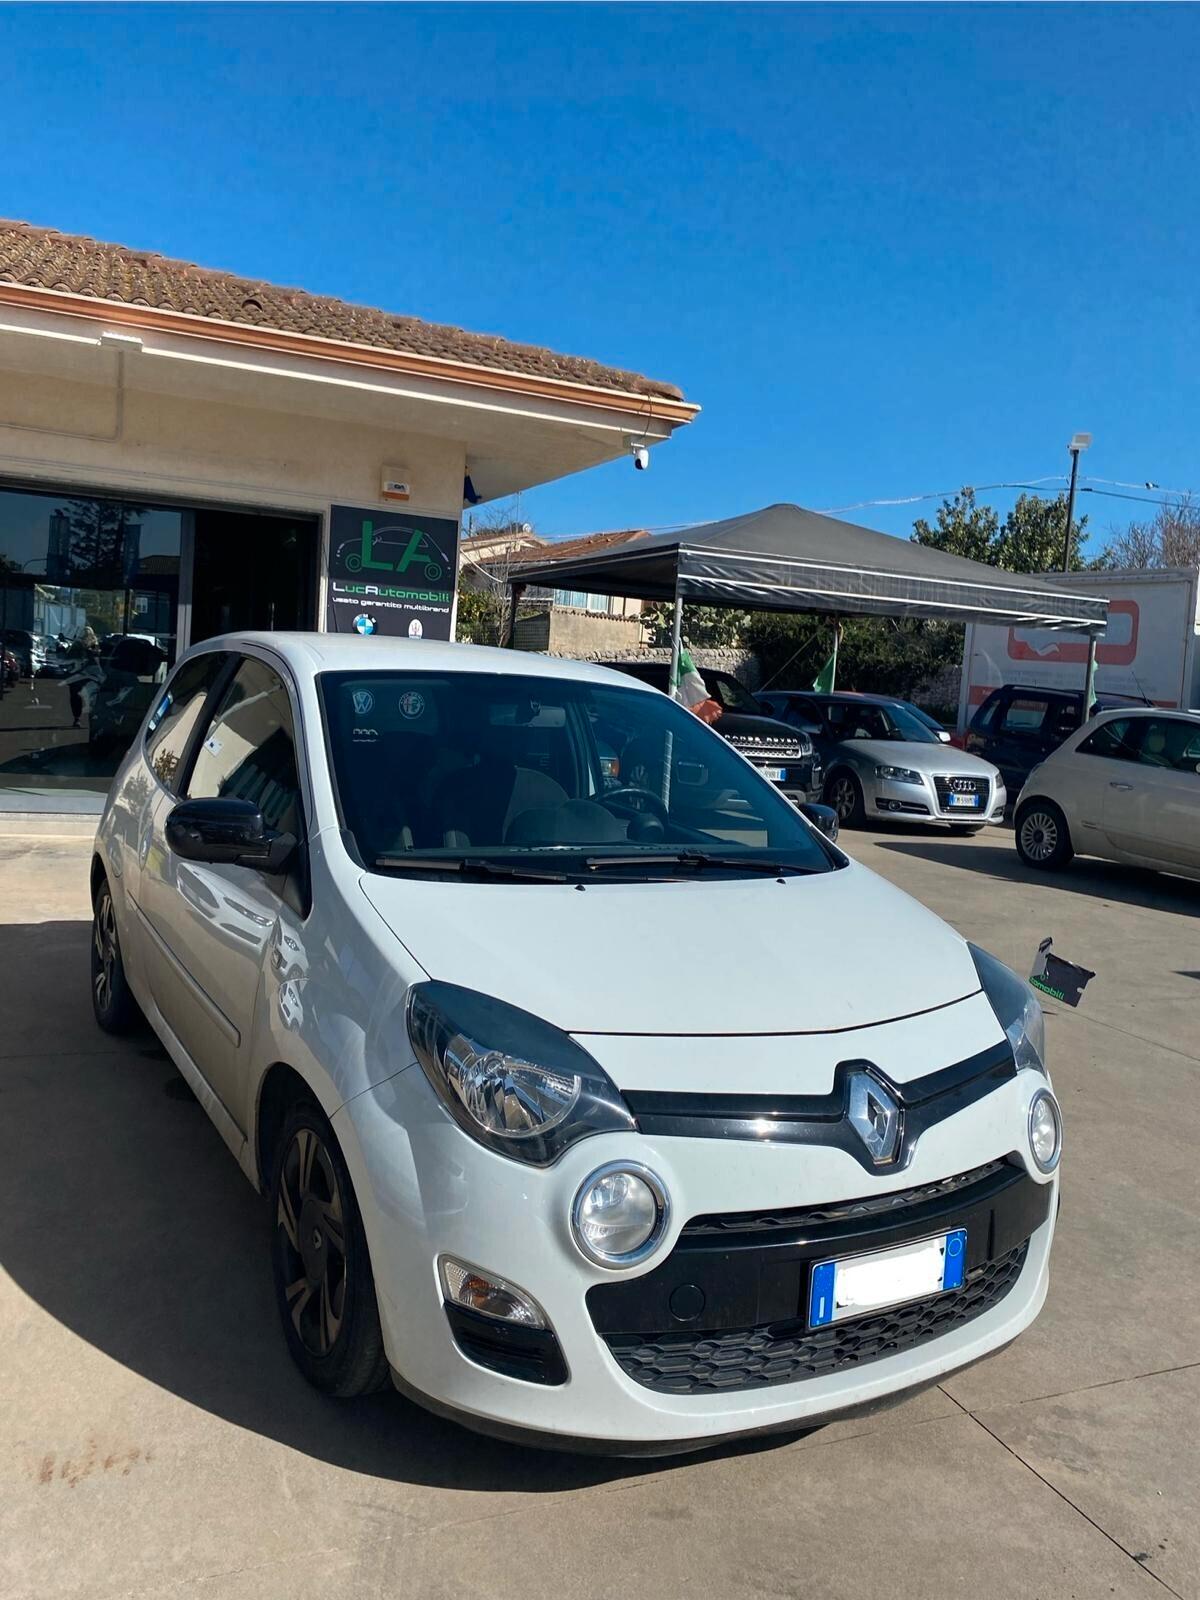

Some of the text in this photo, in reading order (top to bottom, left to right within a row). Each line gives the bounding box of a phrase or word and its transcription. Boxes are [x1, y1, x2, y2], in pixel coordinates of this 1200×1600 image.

[362, 520, 432, 572] LA
[332, 581, 450, 602] LucAutomobili
[332, 597, 450, 613] usato garantito multibrand
